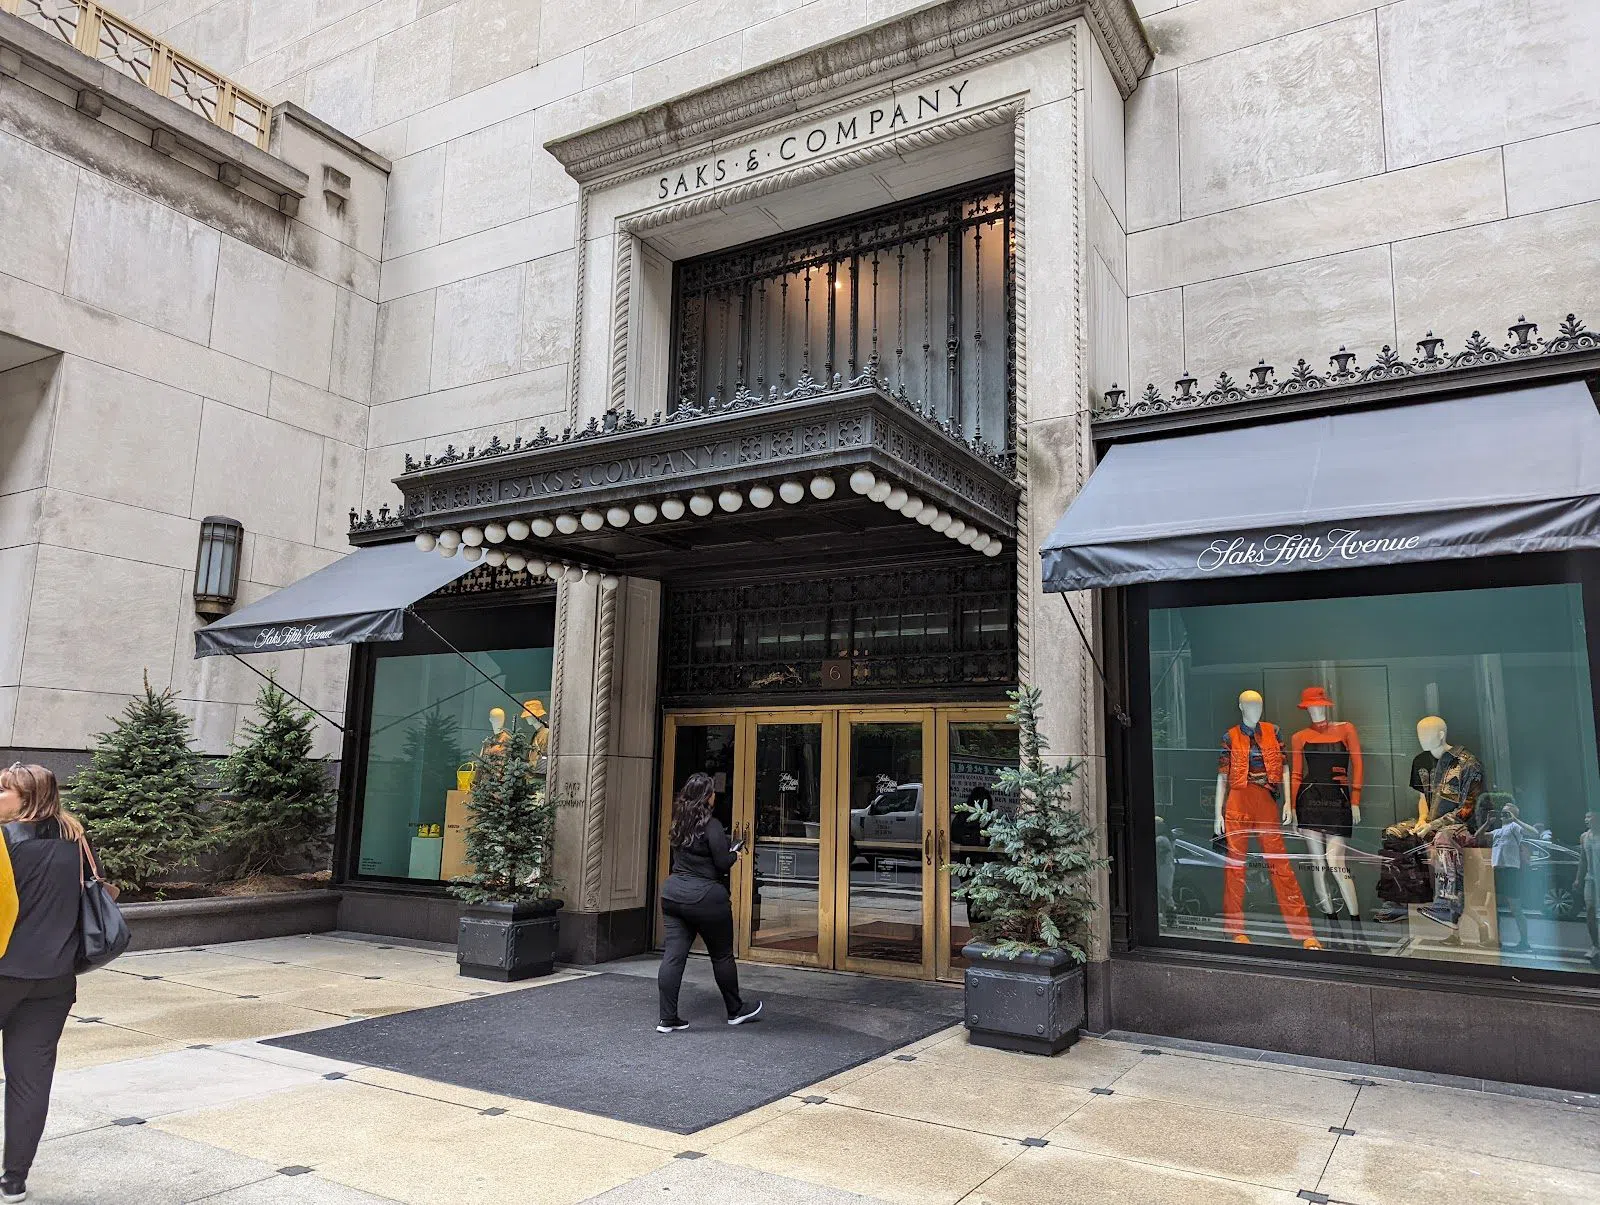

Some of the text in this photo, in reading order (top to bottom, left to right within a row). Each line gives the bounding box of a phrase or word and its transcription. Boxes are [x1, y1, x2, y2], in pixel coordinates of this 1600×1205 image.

[658, 80, 969, 199] SAKS & COMPANY
[511, 469, 564, 499] SAKS
[589, 444, 723, 486] COMPANY
[1196, 528, 1420, 572] Saks Fifth Avenue
[254, 624, 335, 648] Saks Fifth Avenue
[829, 665, 841, 680] 6
